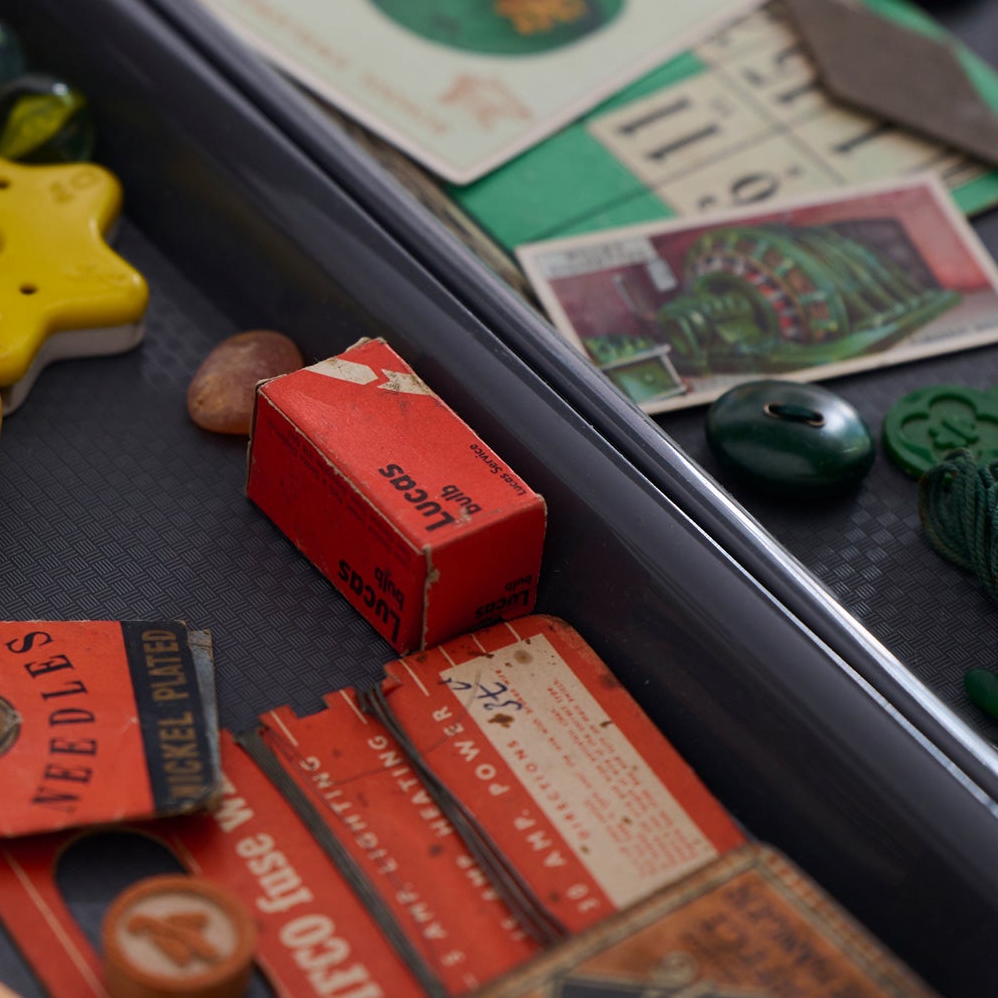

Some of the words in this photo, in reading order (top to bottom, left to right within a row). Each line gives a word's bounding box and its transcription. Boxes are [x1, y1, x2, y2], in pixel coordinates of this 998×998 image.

[379, 462, 456, 532] Lucas
[441, 484, 482, 515] bulb
[469, 443, 502, 475] Service
[499, 472, 526, 496] Lucas
[337, 559, 402, 645] Lucas
[473, 588, 530, 620] Lucas
[142, 629, 189, 704] PLATED
[9, 629, 98, 813] NEEDLES
[156, 709, 205, 810] NICKEL
[432, 706, 510, 796] POWER
[299, 755, 399, 874] LIGHTING
[367, 735, 452, 838] HEATING
[506, 739, 591, 840] DIRECTIONS
[237, 833, 313, 913] fuse
